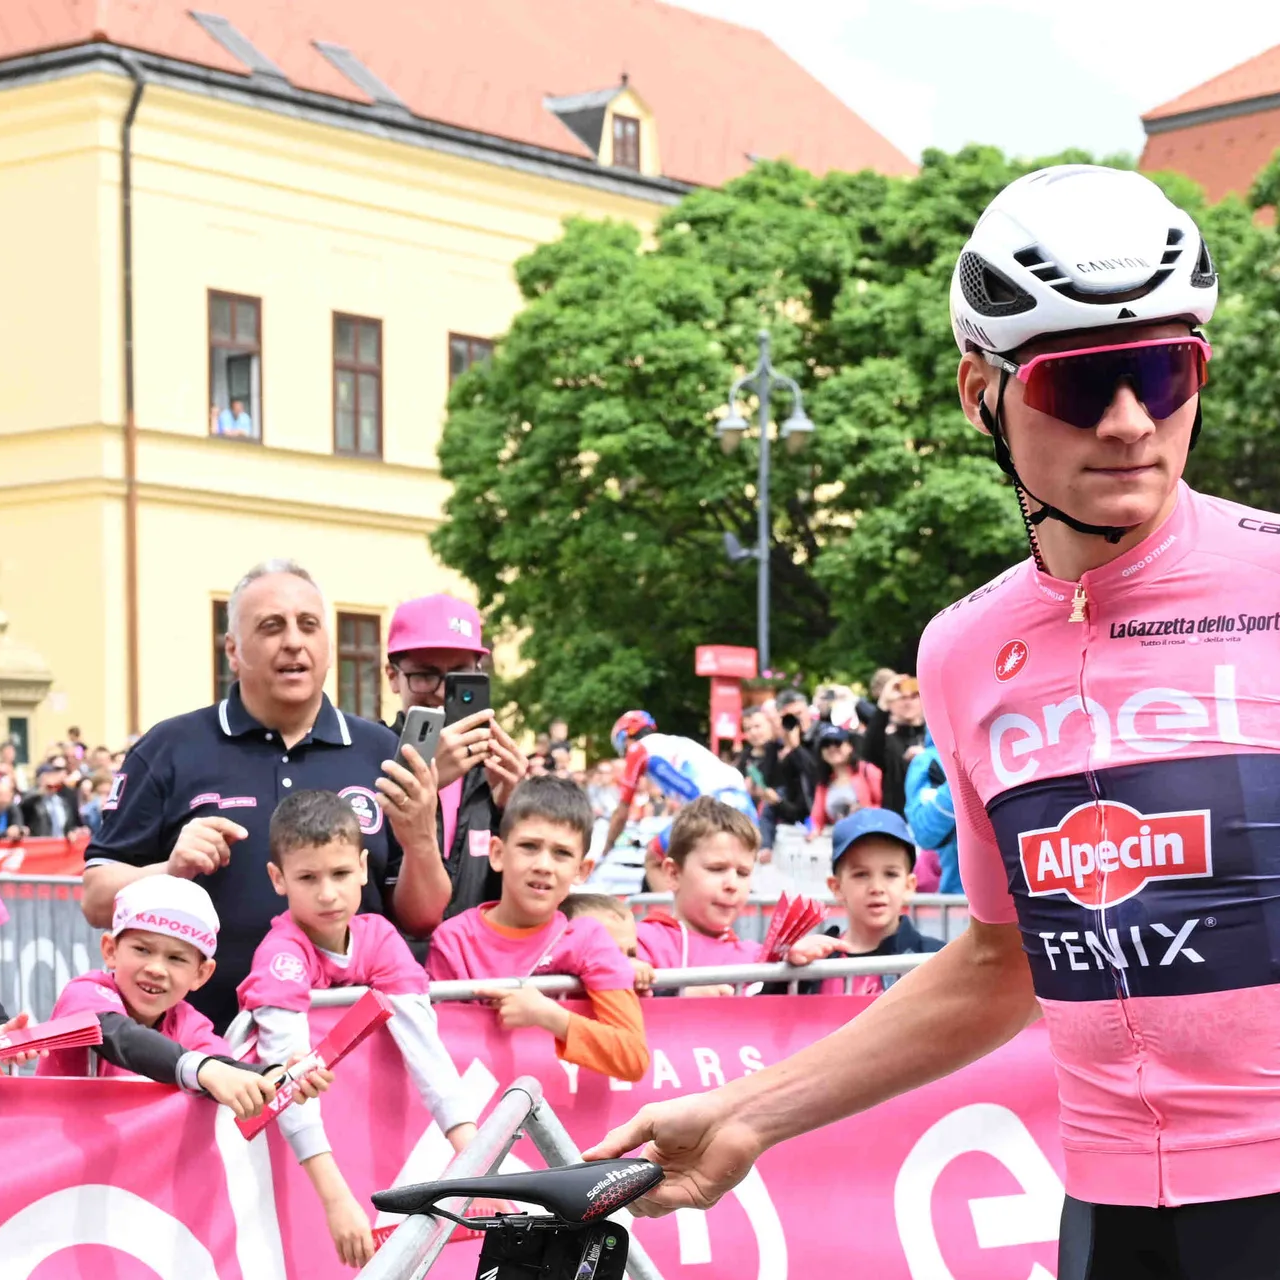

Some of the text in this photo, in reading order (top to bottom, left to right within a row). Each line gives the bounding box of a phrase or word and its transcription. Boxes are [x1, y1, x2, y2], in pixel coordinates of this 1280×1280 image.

[1076, 258, 1151, 274] CANYON
[1121, 560, 1145, 579] GIRO
[1196, 614, 1236, 634] dello
[989, 664, 1254, 786] enel
[1036, 826, 1185, 882] Alpecin
[135, 912, 217, 948] KAPOSVÁR
[1042, 918, 1206, 972] FENIX
